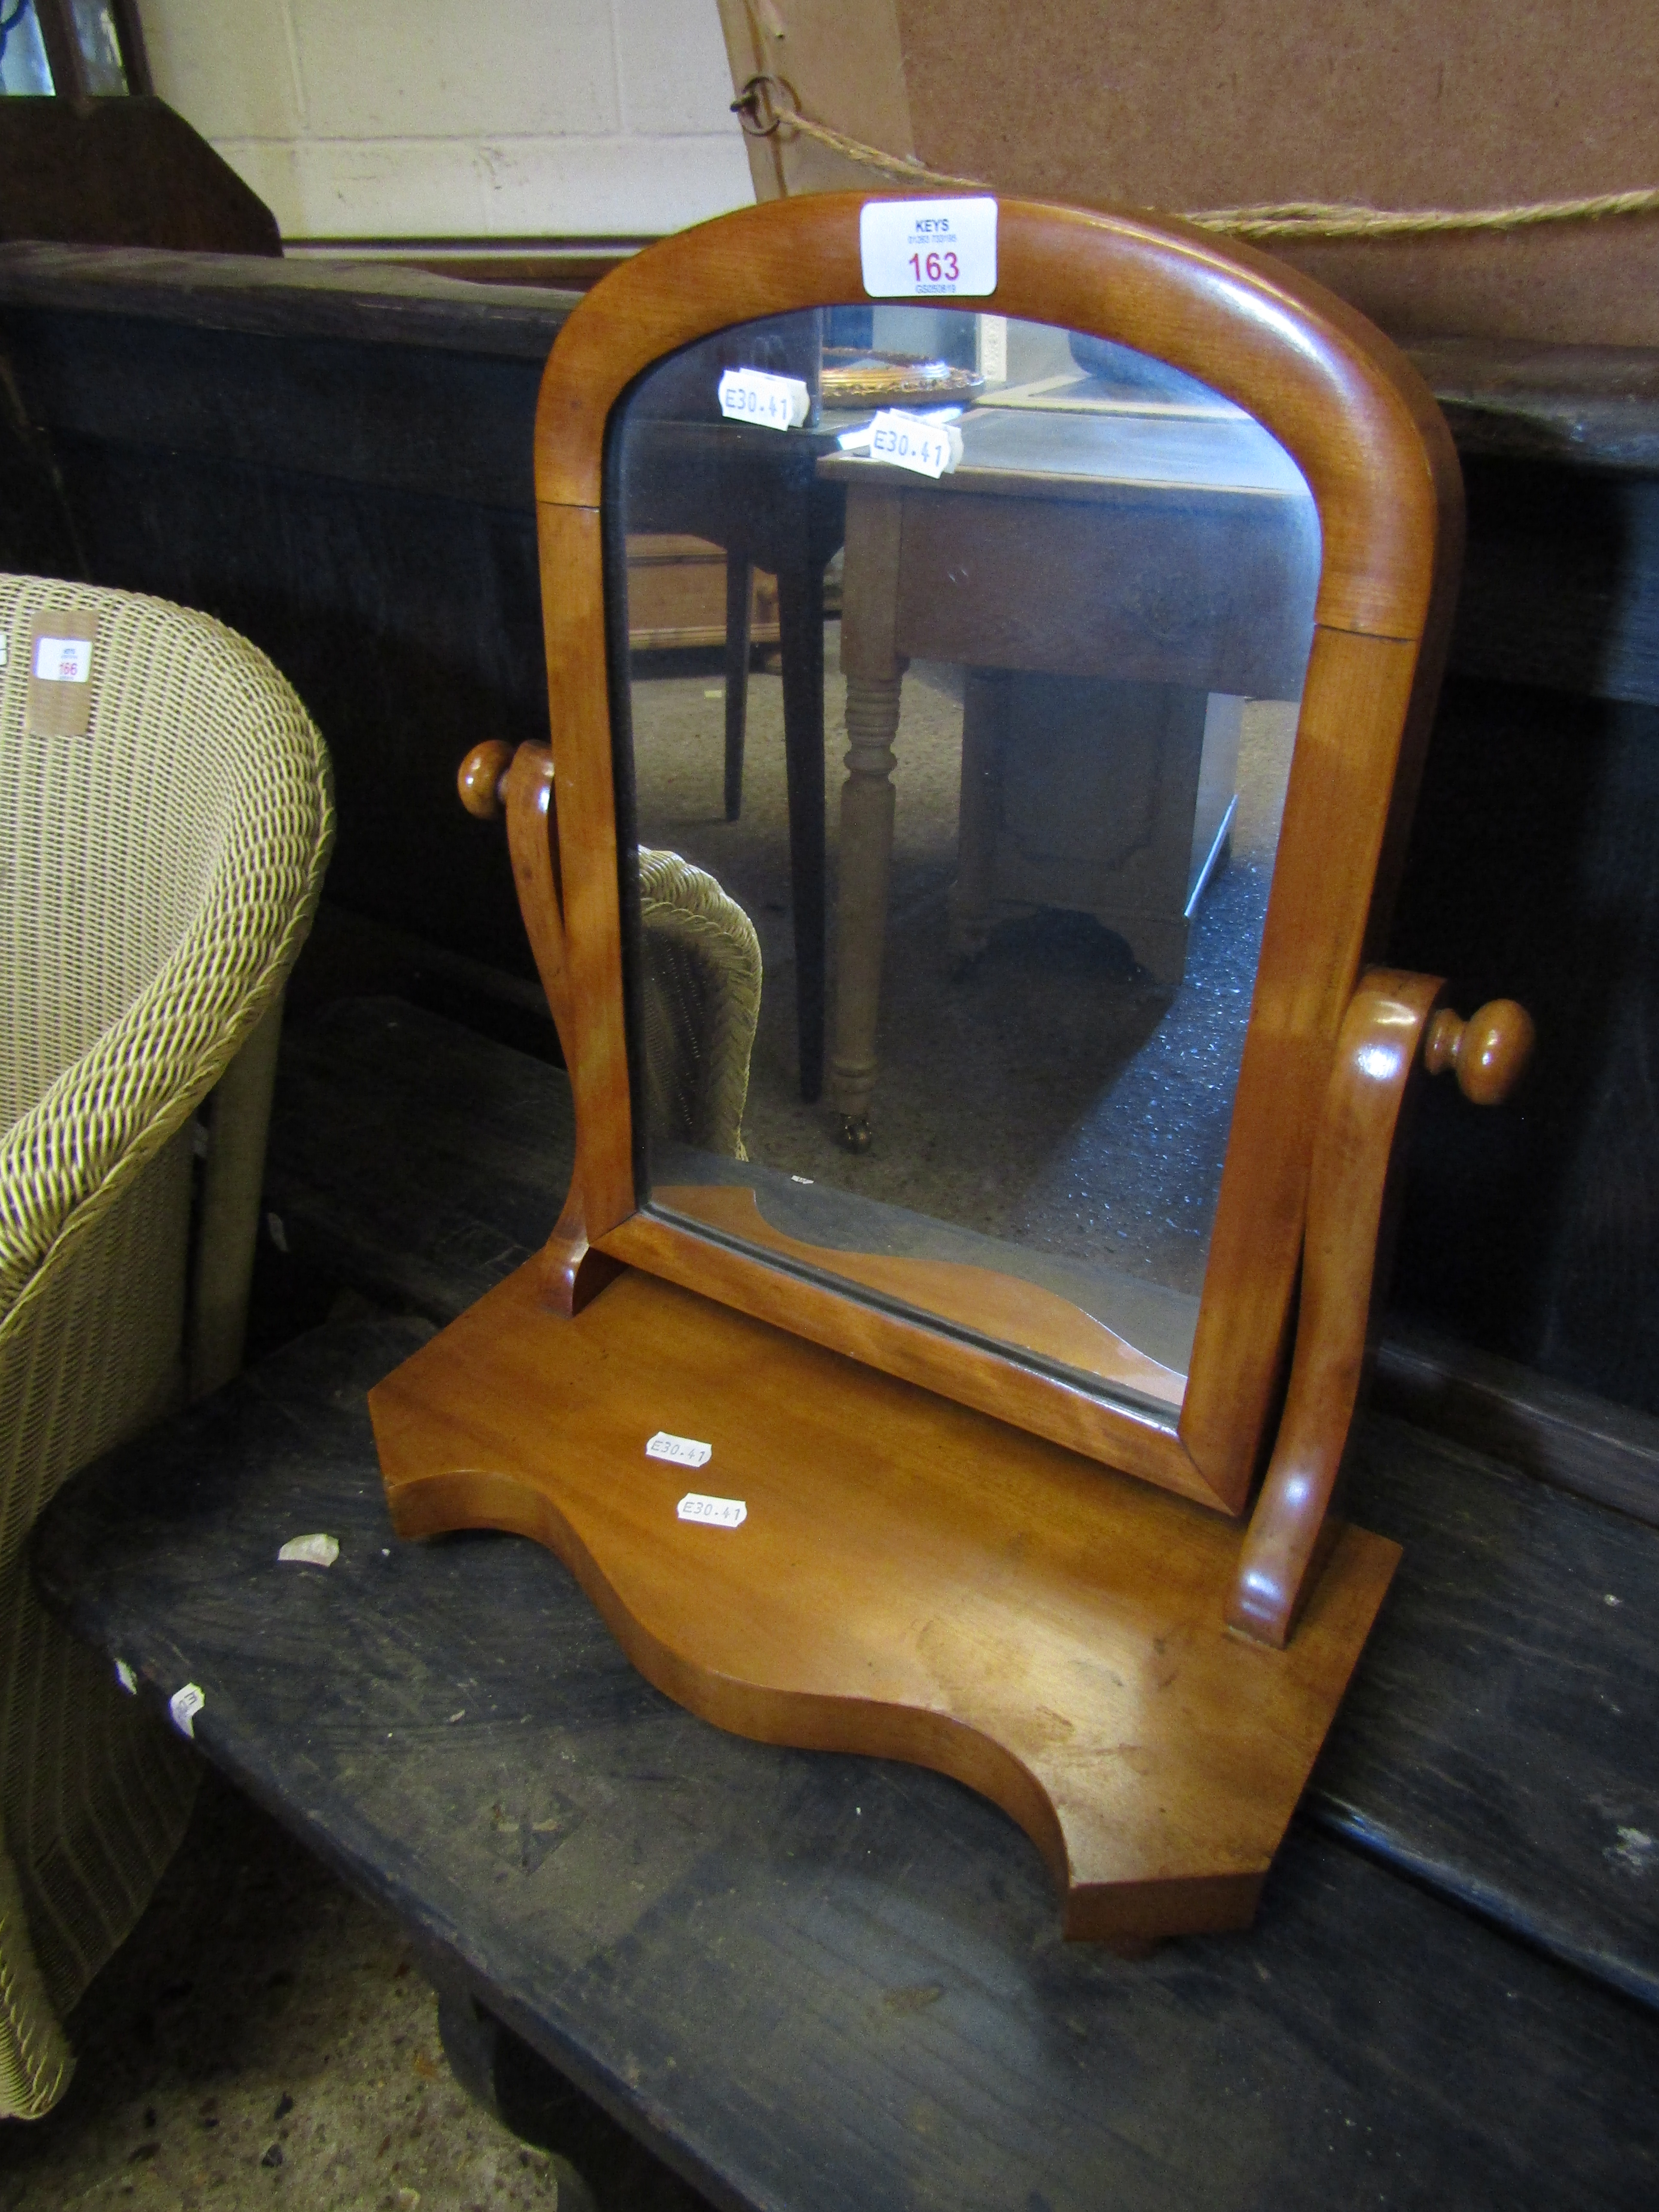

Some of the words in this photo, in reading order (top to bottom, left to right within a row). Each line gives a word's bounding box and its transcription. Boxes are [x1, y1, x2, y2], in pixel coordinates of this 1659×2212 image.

[915, 219, 949, 232] KEYS
[909, 252, 959, 282] 163
[725, 389, 788, 420] E30.41
[873, 430, 942, 468] E30.41
[650, 1440, 705, 1462] E30.41
[683, 1501, 741, 1521] E30.41
